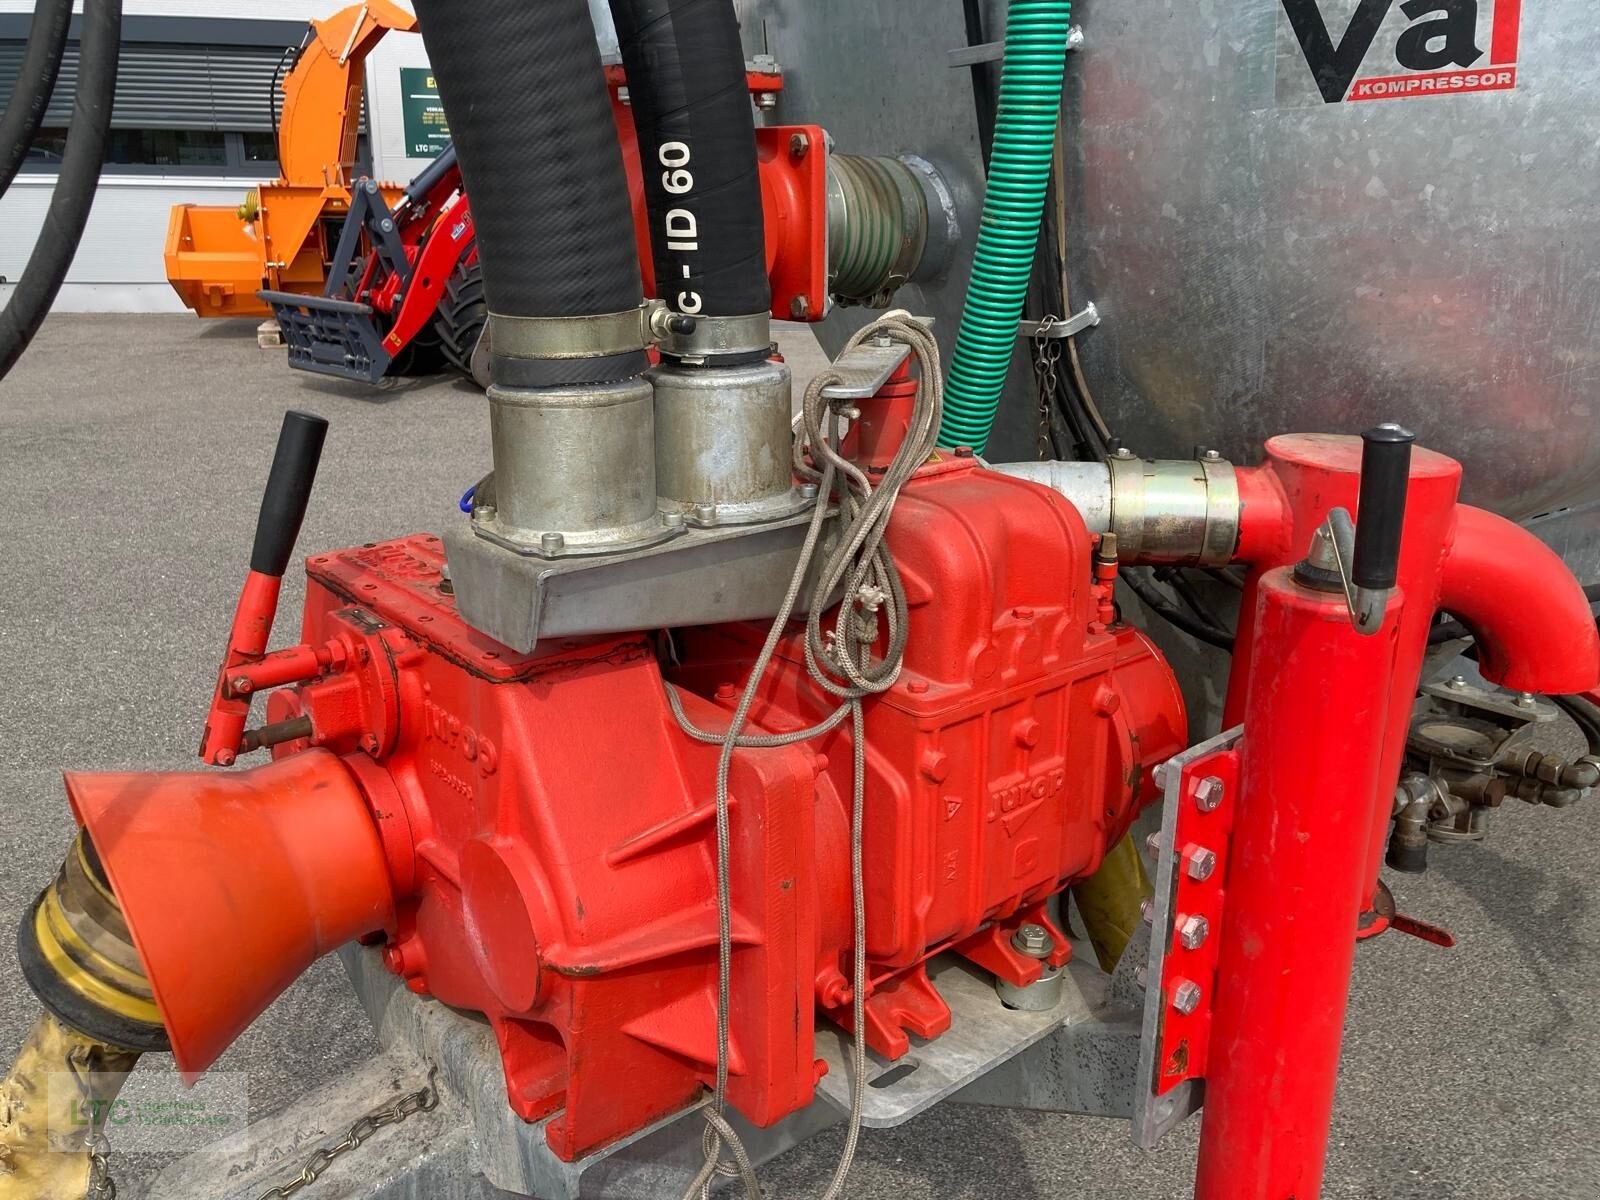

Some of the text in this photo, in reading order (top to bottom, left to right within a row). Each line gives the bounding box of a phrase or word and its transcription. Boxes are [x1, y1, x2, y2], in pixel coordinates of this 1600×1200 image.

[1358, 72, 1512, 97] KOMPRESSOR
[415, 144, 429, 153] LTC
[658, 141, 694, 195] 60
[665, 208, 698, 251] ID
